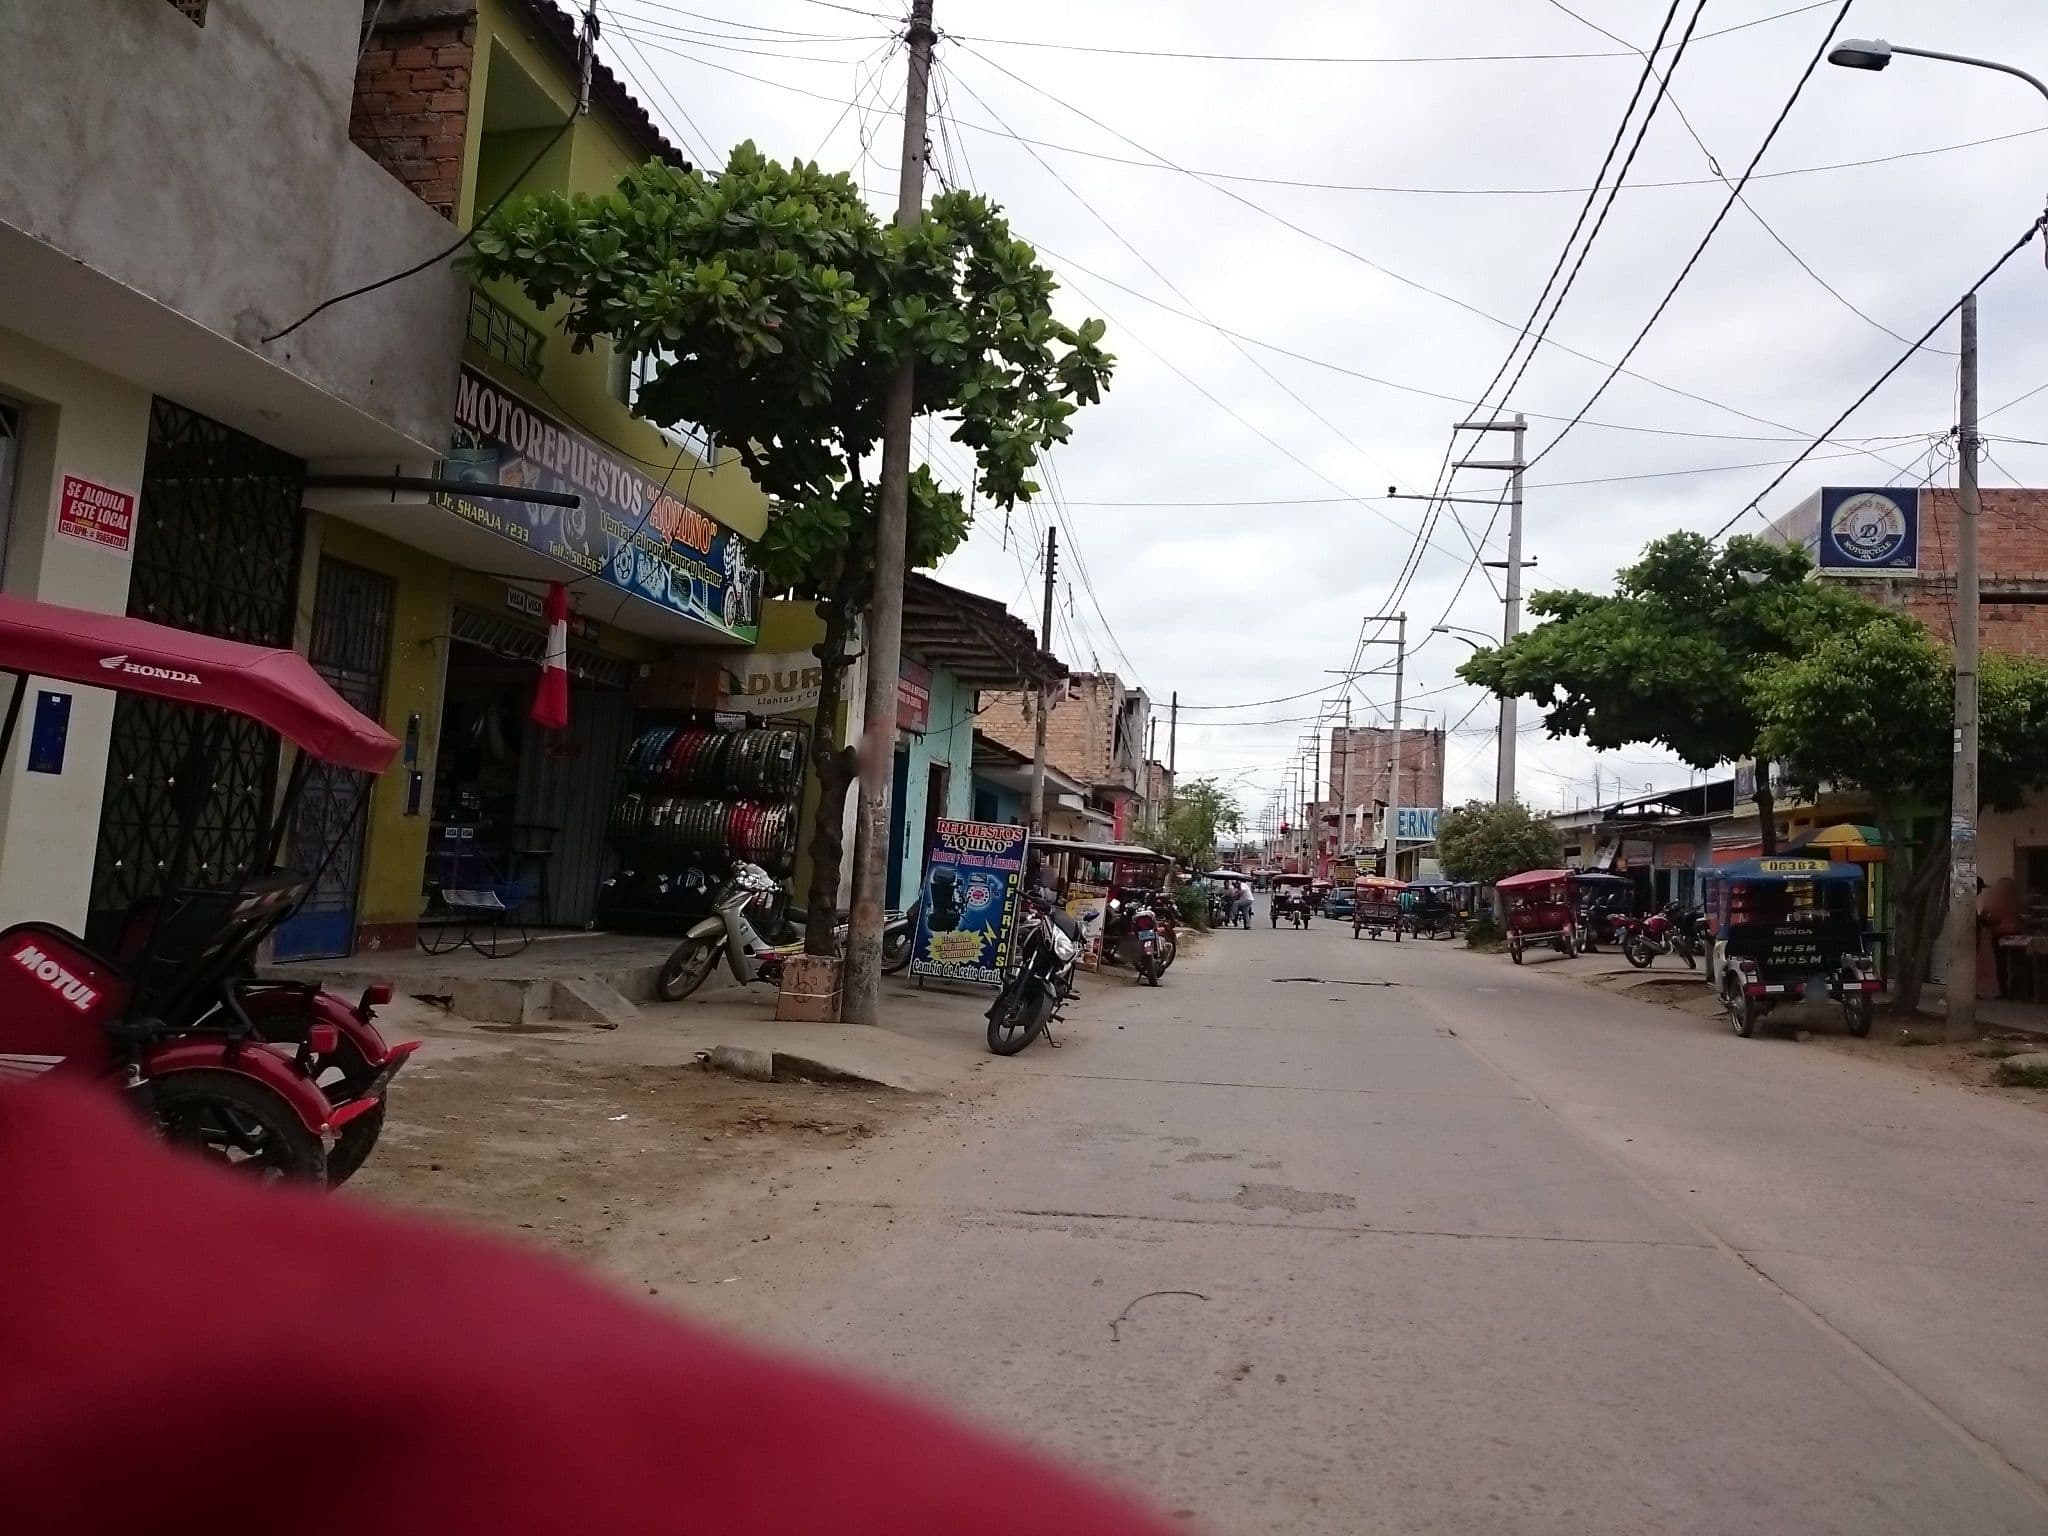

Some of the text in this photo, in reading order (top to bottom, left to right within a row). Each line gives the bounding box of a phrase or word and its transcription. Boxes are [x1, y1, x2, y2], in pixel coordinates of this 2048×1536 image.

[456, 373, 642, 516] MOTOREPUESTOS
[66, 481, 126, 512] SE ALQUILA
[69, 500, 129, 530] ESTE LOCAL
[441, 492, 454, 510] Jr.
[458, 500, 502, 531] SHAPAJA
[1843, 540, 1893, 556] MOTORCYCLE
[571, 549, 602, 575] 503563
[509, 590, 543, 615] VISA VISA
[123, 662, 202, 684] HONDA
[937, 820, 1023, 841] REPUESTOS
[941, 834, 1014, 854] "AQUINO"
[996, 873, 1018, 967] OFERTAS
[1774, 927, 1813, 935] HONDA
[12, 945, 97, 1010] MOTUL
[912, 957, 942, 976] Cambio
[942, 962, 953, 977] de
[953, 963, 979, 981] Aceite
